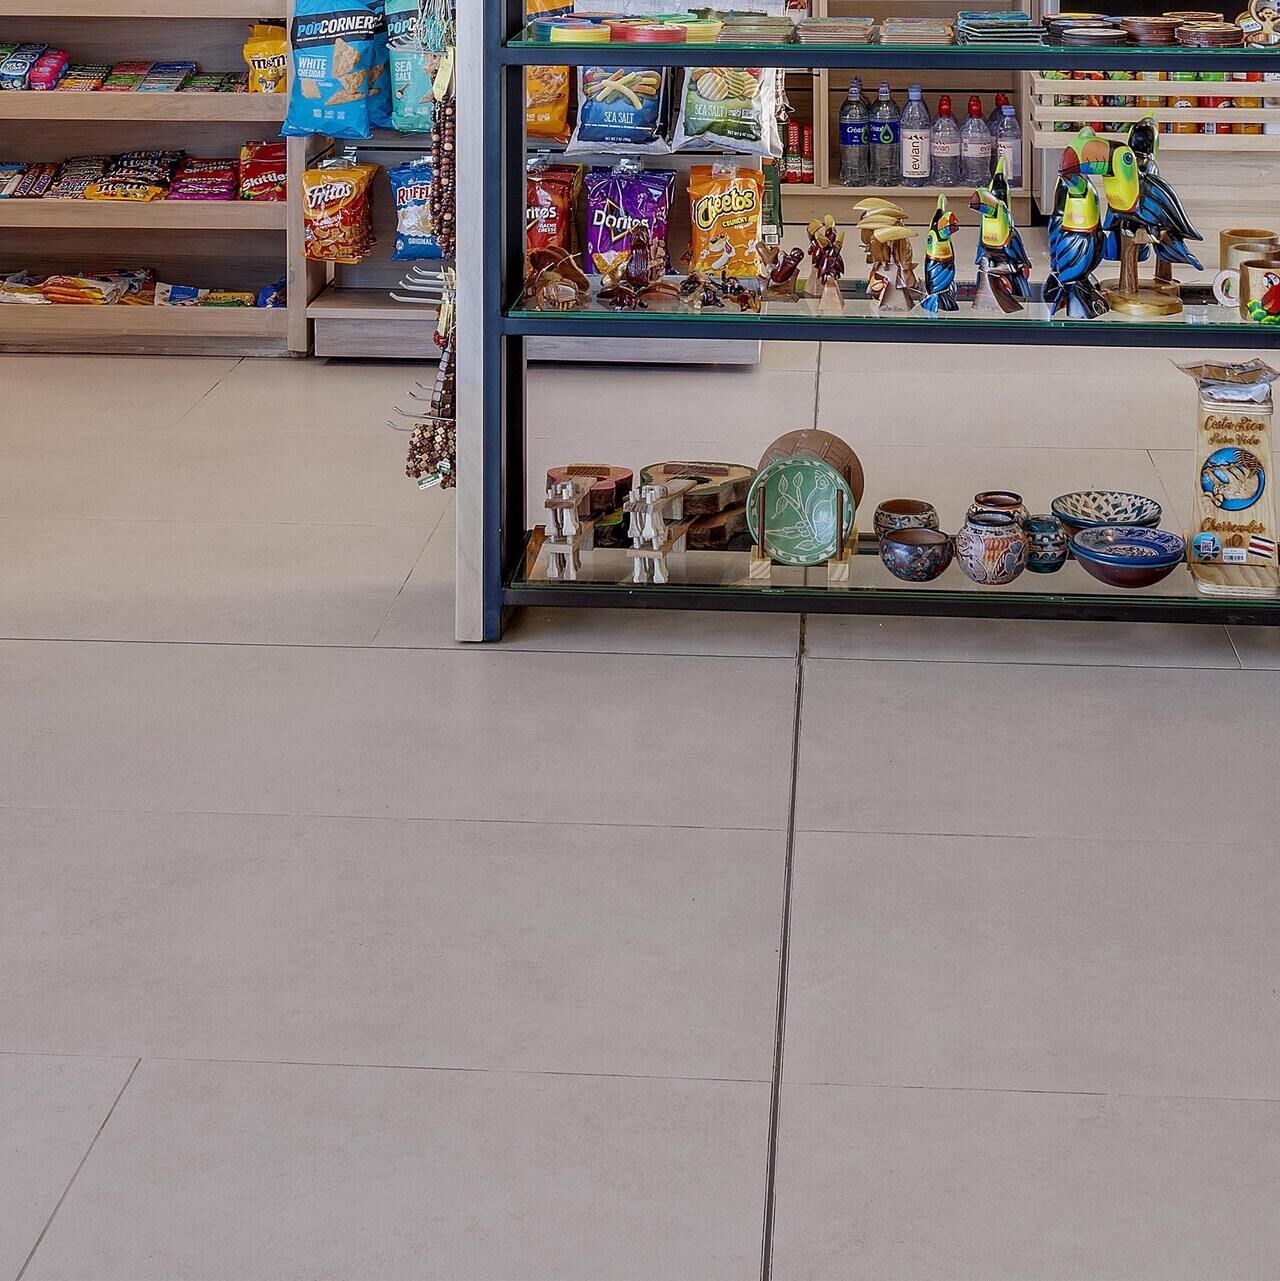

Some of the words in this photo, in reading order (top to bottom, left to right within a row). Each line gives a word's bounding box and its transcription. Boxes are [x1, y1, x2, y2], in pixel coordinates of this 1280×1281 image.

[299, 58, 327, 70] WHITE
[395, 62, 412, 72] SEA
[298, 70, 326, 78] CHEDDAR
[396, 72, 412, 81] SALT
[604, 112, 618, 124] SEA
[618, 112, 634, 124] SALT
[912, 142, 920, 170] evian
[242, 174, 286, 190] Skittle
[307, 182, 352, 208] Fritos
[397, 184, 432, 206] RUFFL
[697, 190, 754, 230] Cheetos
[1204, 415, 1233, 432] Costa
[1234, 416, 1264, 432] Rica
[1199, 517, 1266, 534] Chorreador
